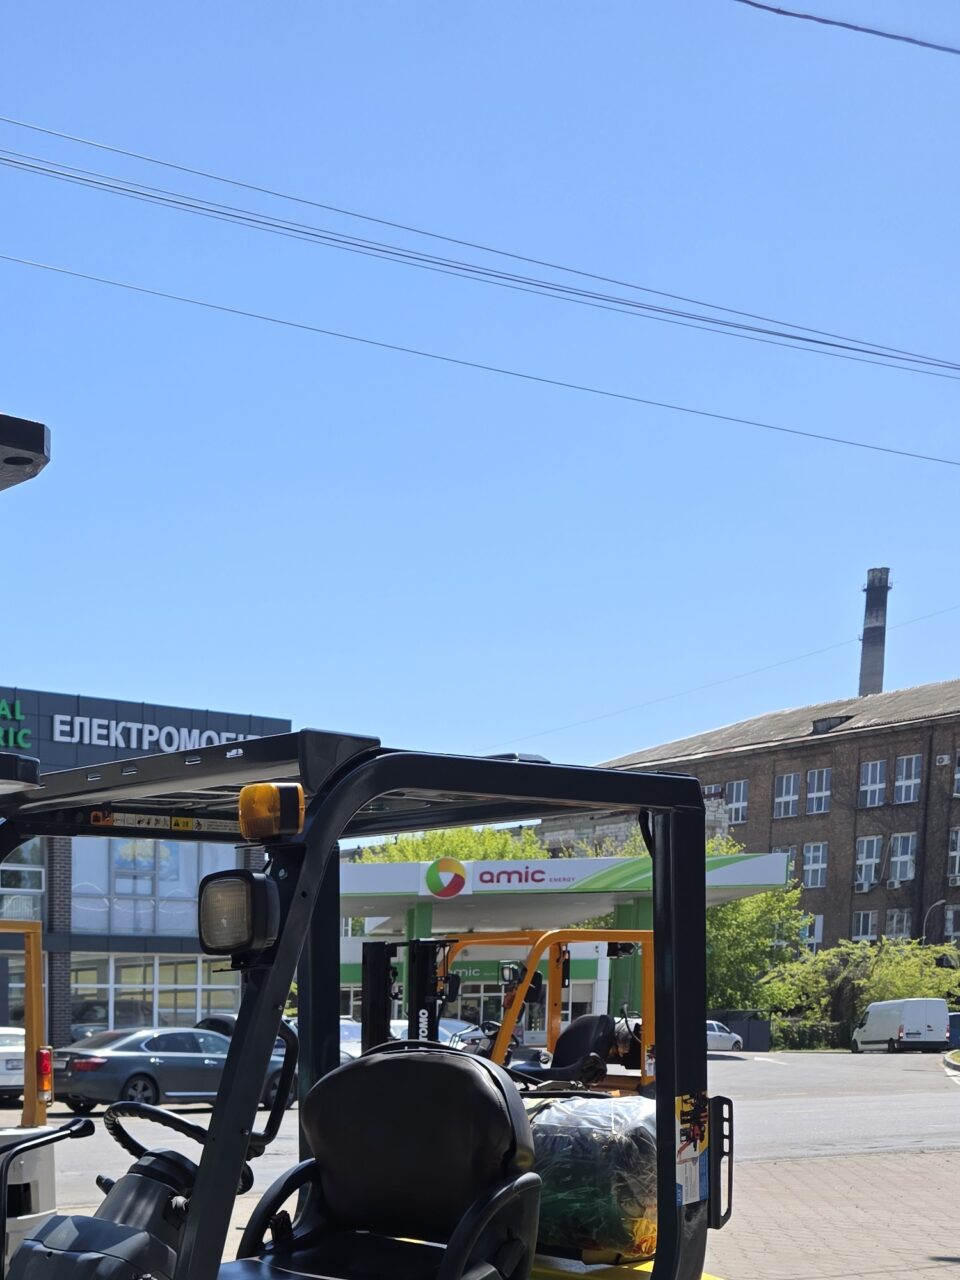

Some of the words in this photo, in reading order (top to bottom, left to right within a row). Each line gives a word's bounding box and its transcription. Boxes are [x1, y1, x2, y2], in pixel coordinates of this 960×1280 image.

[53, 714, 263, 753] ЕЛЕКТРОМО
[479, 865, 546, 884] amic
[448, 966, 481, 977] mic
